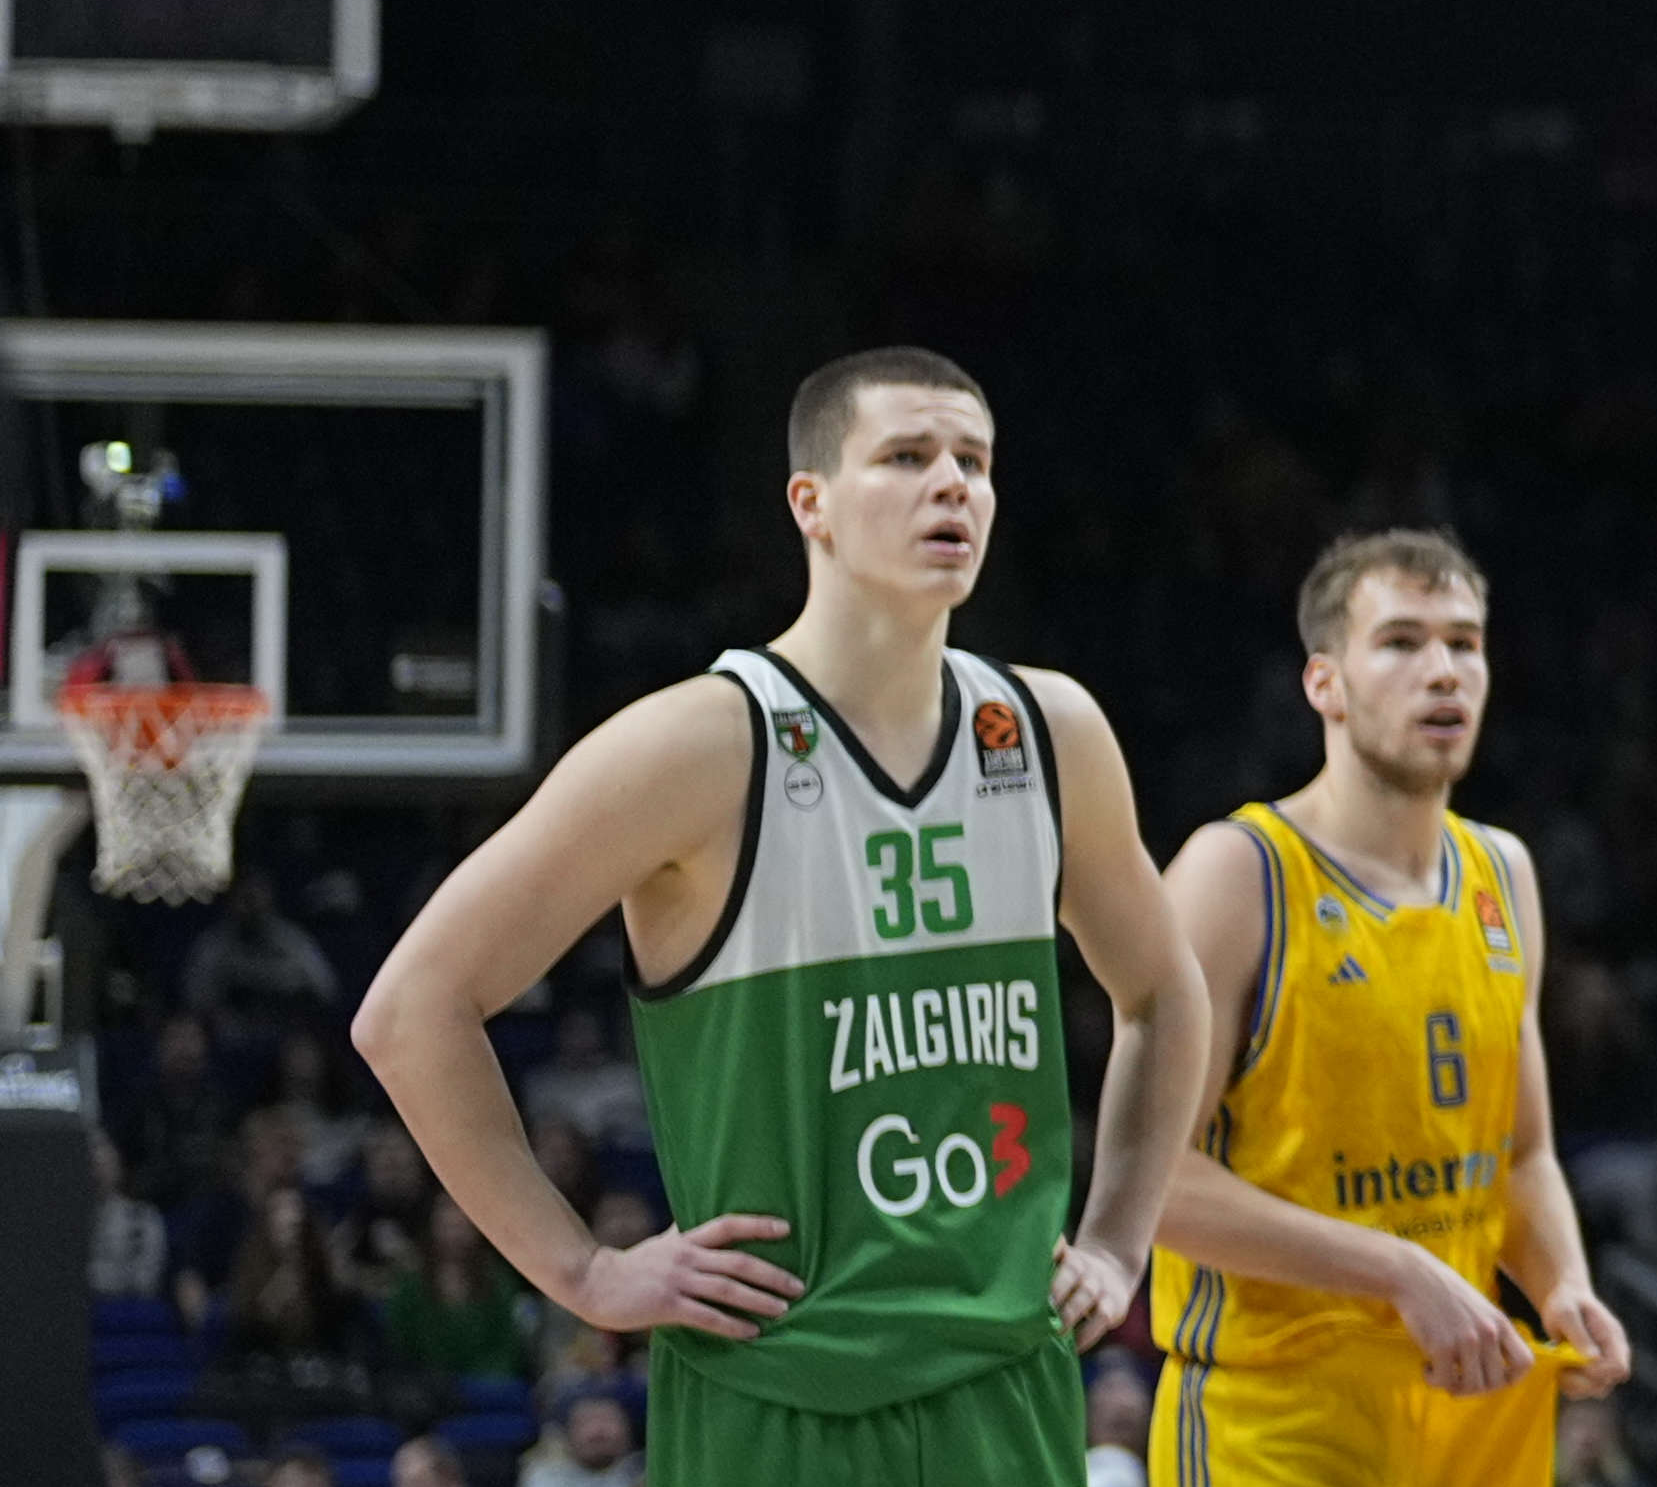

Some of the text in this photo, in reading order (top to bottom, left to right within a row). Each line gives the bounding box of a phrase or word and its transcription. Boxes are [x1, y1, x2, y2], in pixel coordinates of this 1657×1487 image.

[865, 823, 974, 941] 35
[1426, 1012, 1468, 1109] 6
[857, 1102, 1031, 1217] Go3
